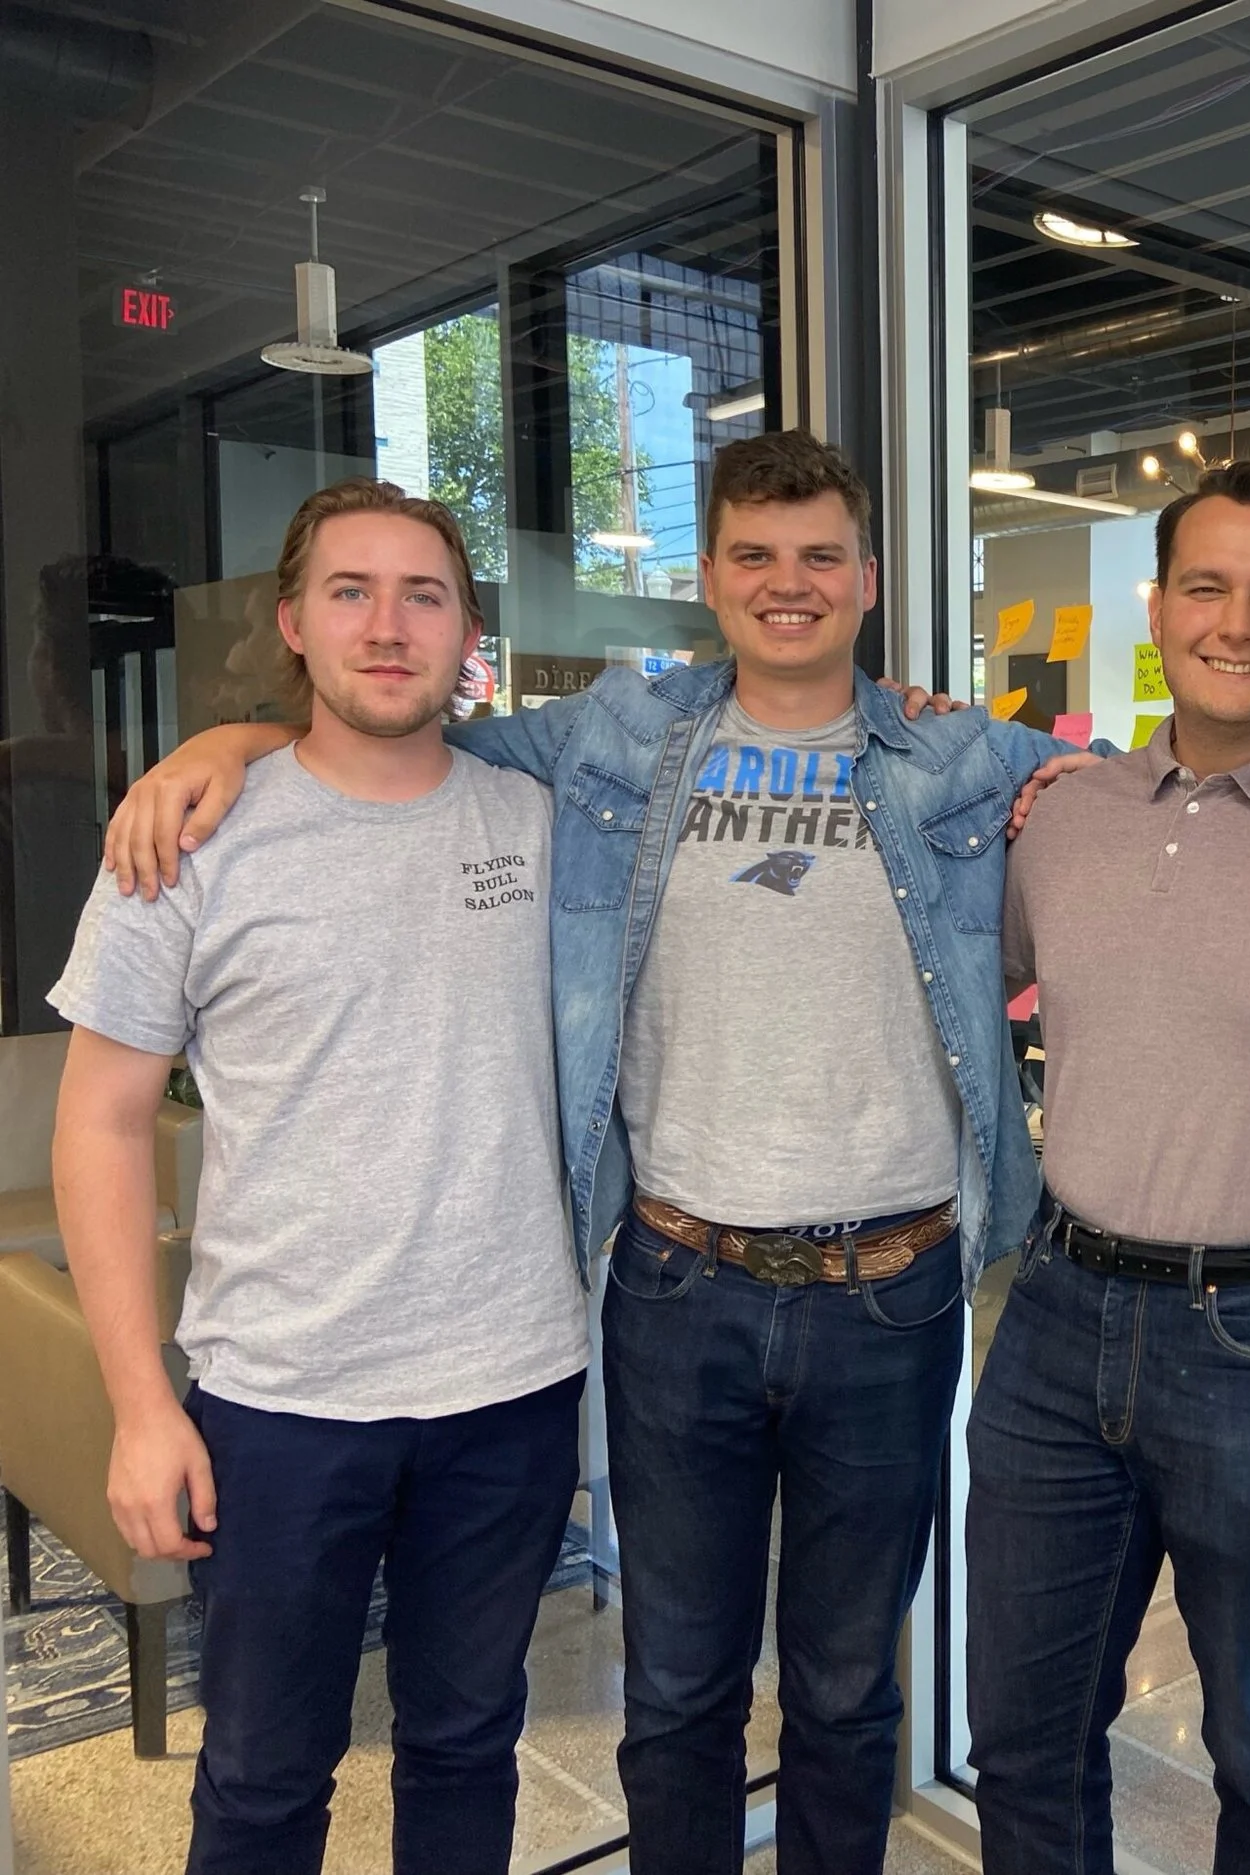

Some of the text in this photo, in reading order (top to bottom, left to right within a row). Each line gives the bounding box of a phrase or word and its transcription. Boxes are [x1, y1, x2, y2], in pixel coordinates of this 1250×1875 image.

[123, 287, 170, 330] EXIT
[1139, 650, 1160, 661] WHA
[1137, 665, 1162, 680] DO W
[460, 855, 526, 875] FLYING
[471, 872, 518, 893] BULL
[463, 888, 535, 911] SALOON
[773, 1219, 863, 1239] ZOD
